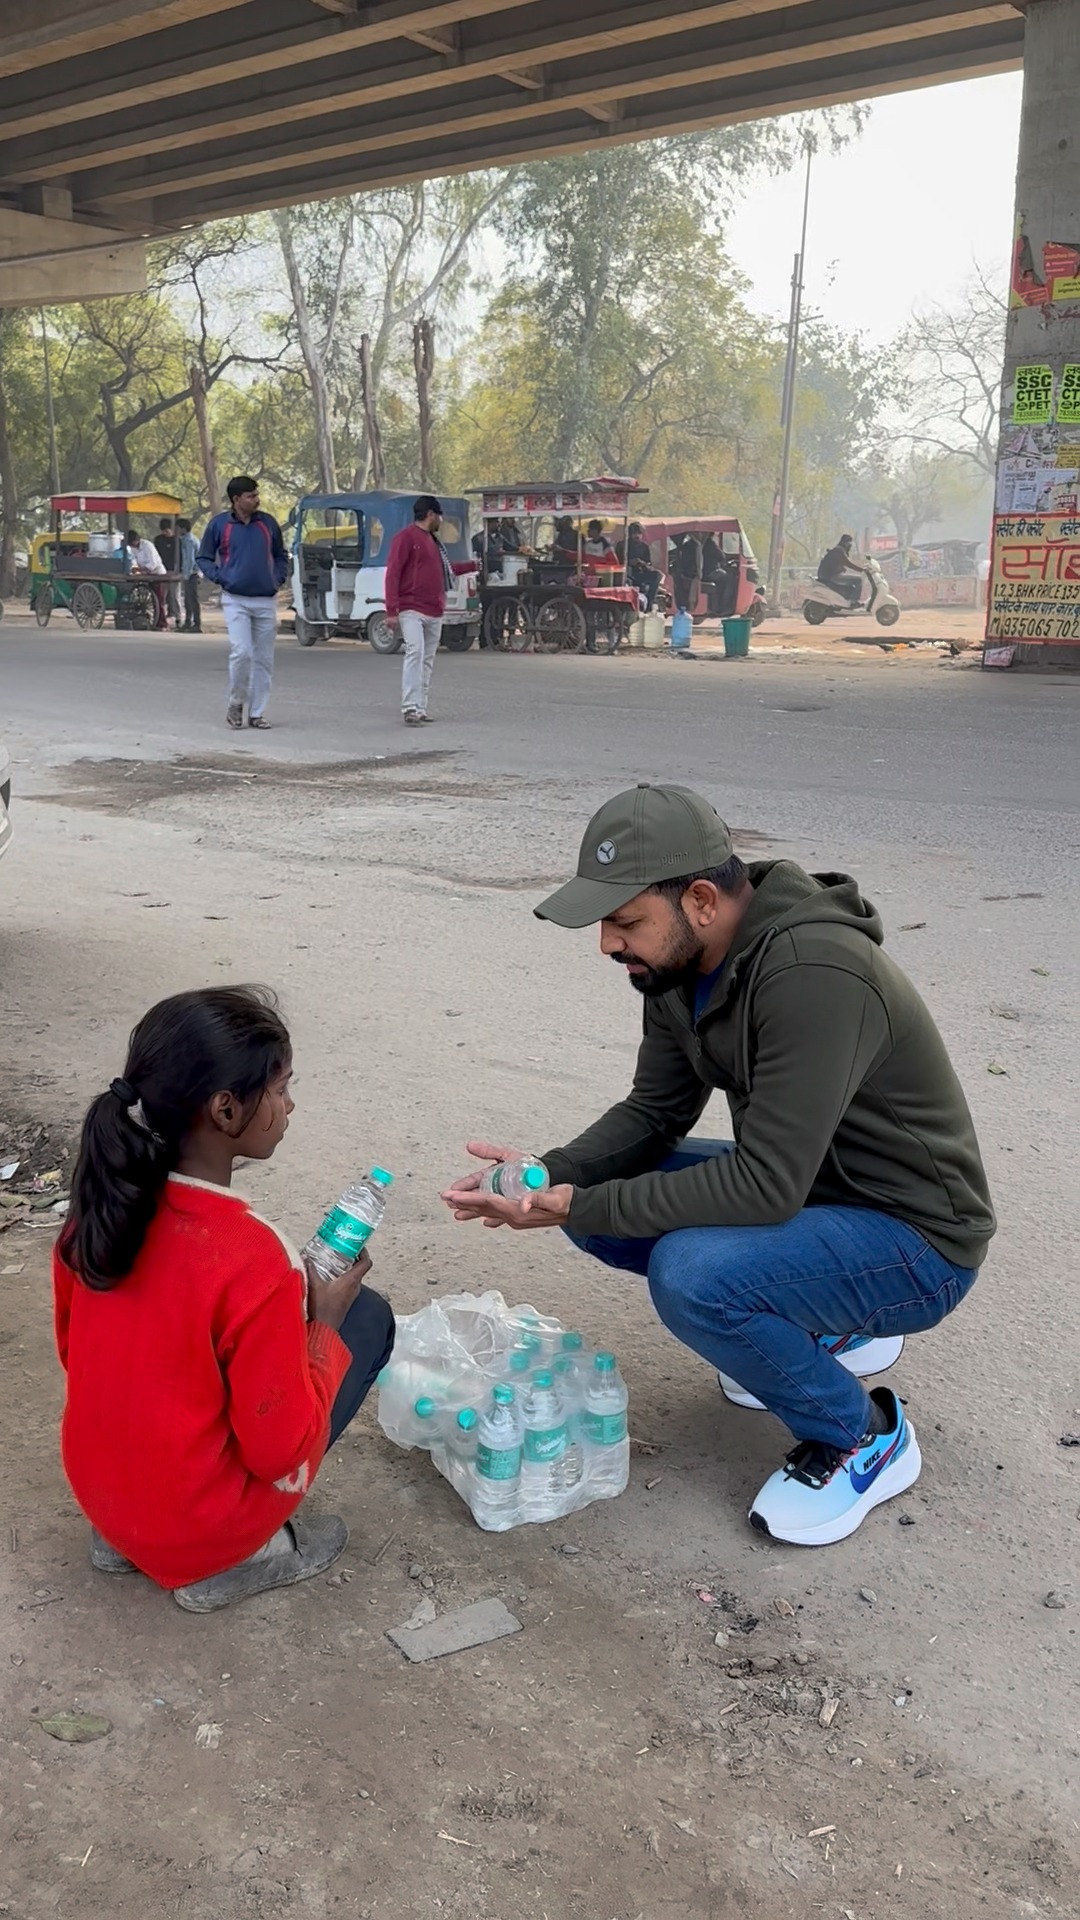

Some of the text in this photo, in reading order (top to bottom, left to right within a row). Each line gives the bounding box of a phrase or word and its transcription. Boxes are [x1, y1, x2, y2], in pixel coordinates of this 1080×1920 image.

[1017, 374, 1052, 389] SSC
[1016, 388, 1051, 402] CTET
[1029, 401, 1051, 410] PET
[863, 1449, 881, 1472] NIKE
